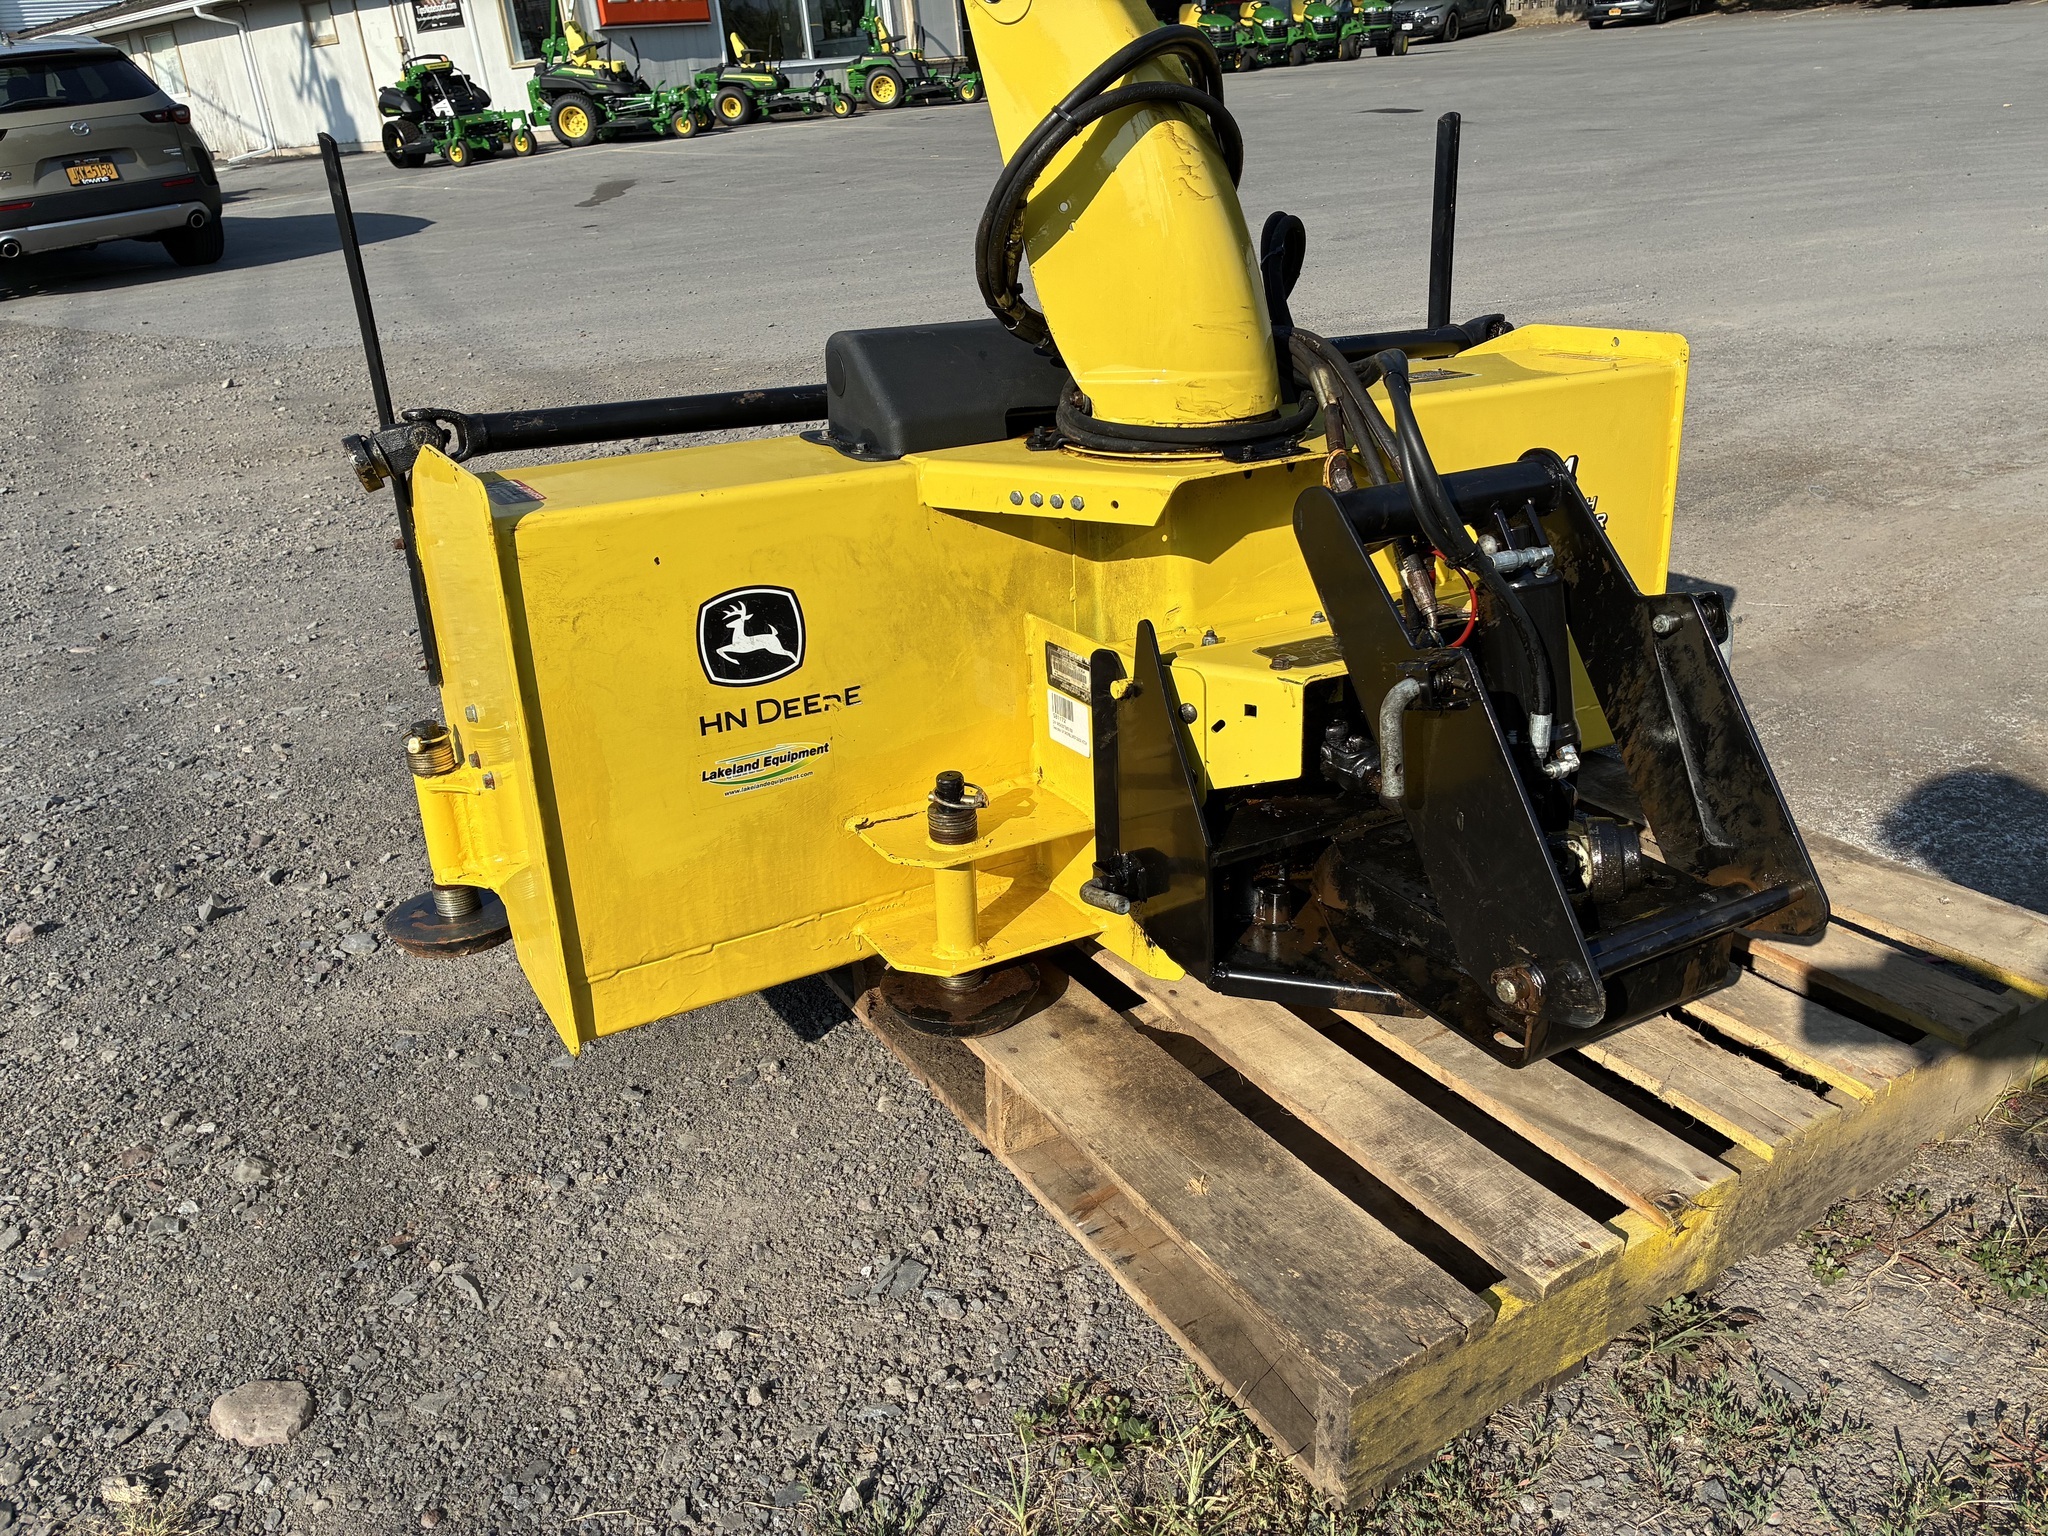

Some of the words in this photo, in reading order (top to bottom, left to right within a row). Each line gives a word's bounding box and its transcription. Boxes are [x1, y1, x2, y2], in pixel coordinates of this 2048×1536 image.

[701, 758, 760, 782] Lakeland
[763, 743, 830, 767] Equipment
[724, 771, 814, 797] www.lakelandequipment.com
